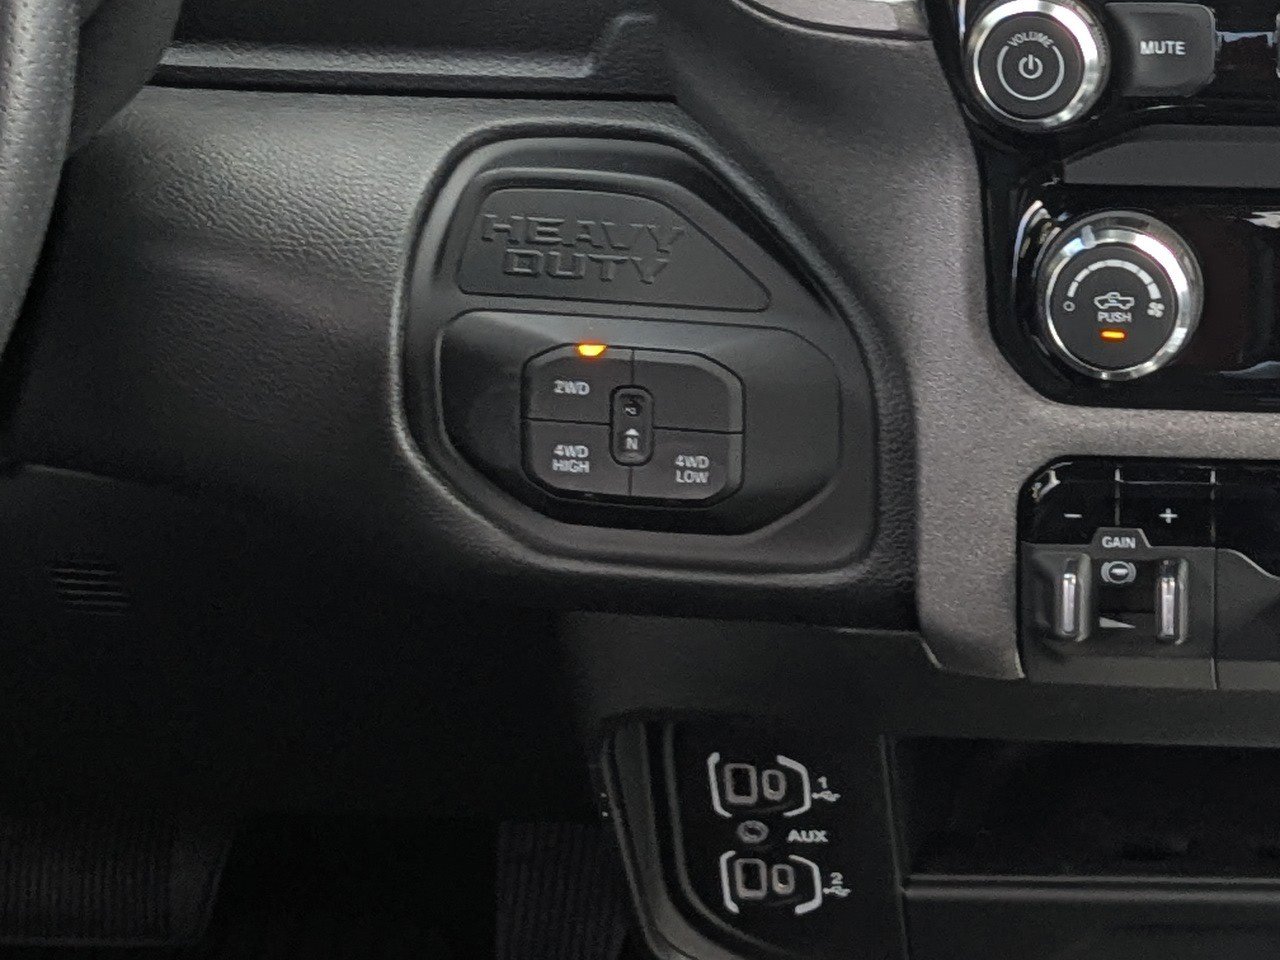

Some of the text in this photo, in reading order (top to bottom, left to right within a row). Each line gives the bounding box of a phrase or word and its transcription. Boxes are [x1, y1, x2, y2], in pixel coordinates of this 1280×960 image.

[1007, 31, 1054, 48] VOLUME
[1139, 40, 1186, 56] MUTE
[481, 214, 685, 253] HEAVY
[503, 249, 672, 284] DUTY
[1097, 311, 1132, 324] PUSH
[554, 380, 590, 396] 2WD
[626, 437, 638, 450] N
[553, 444, 589, 458] 4WD
[552, 459, 590, 473] HIGH
[675, 454, 709, 469] 4WD
[676, 469, 709, 483] LOW
[1101, 536, 1136, 549] GAIN
[817, 776, 828, 789] 1
[787, 829, 829, 843] AUX
[830, 872, 843, 885] 2
